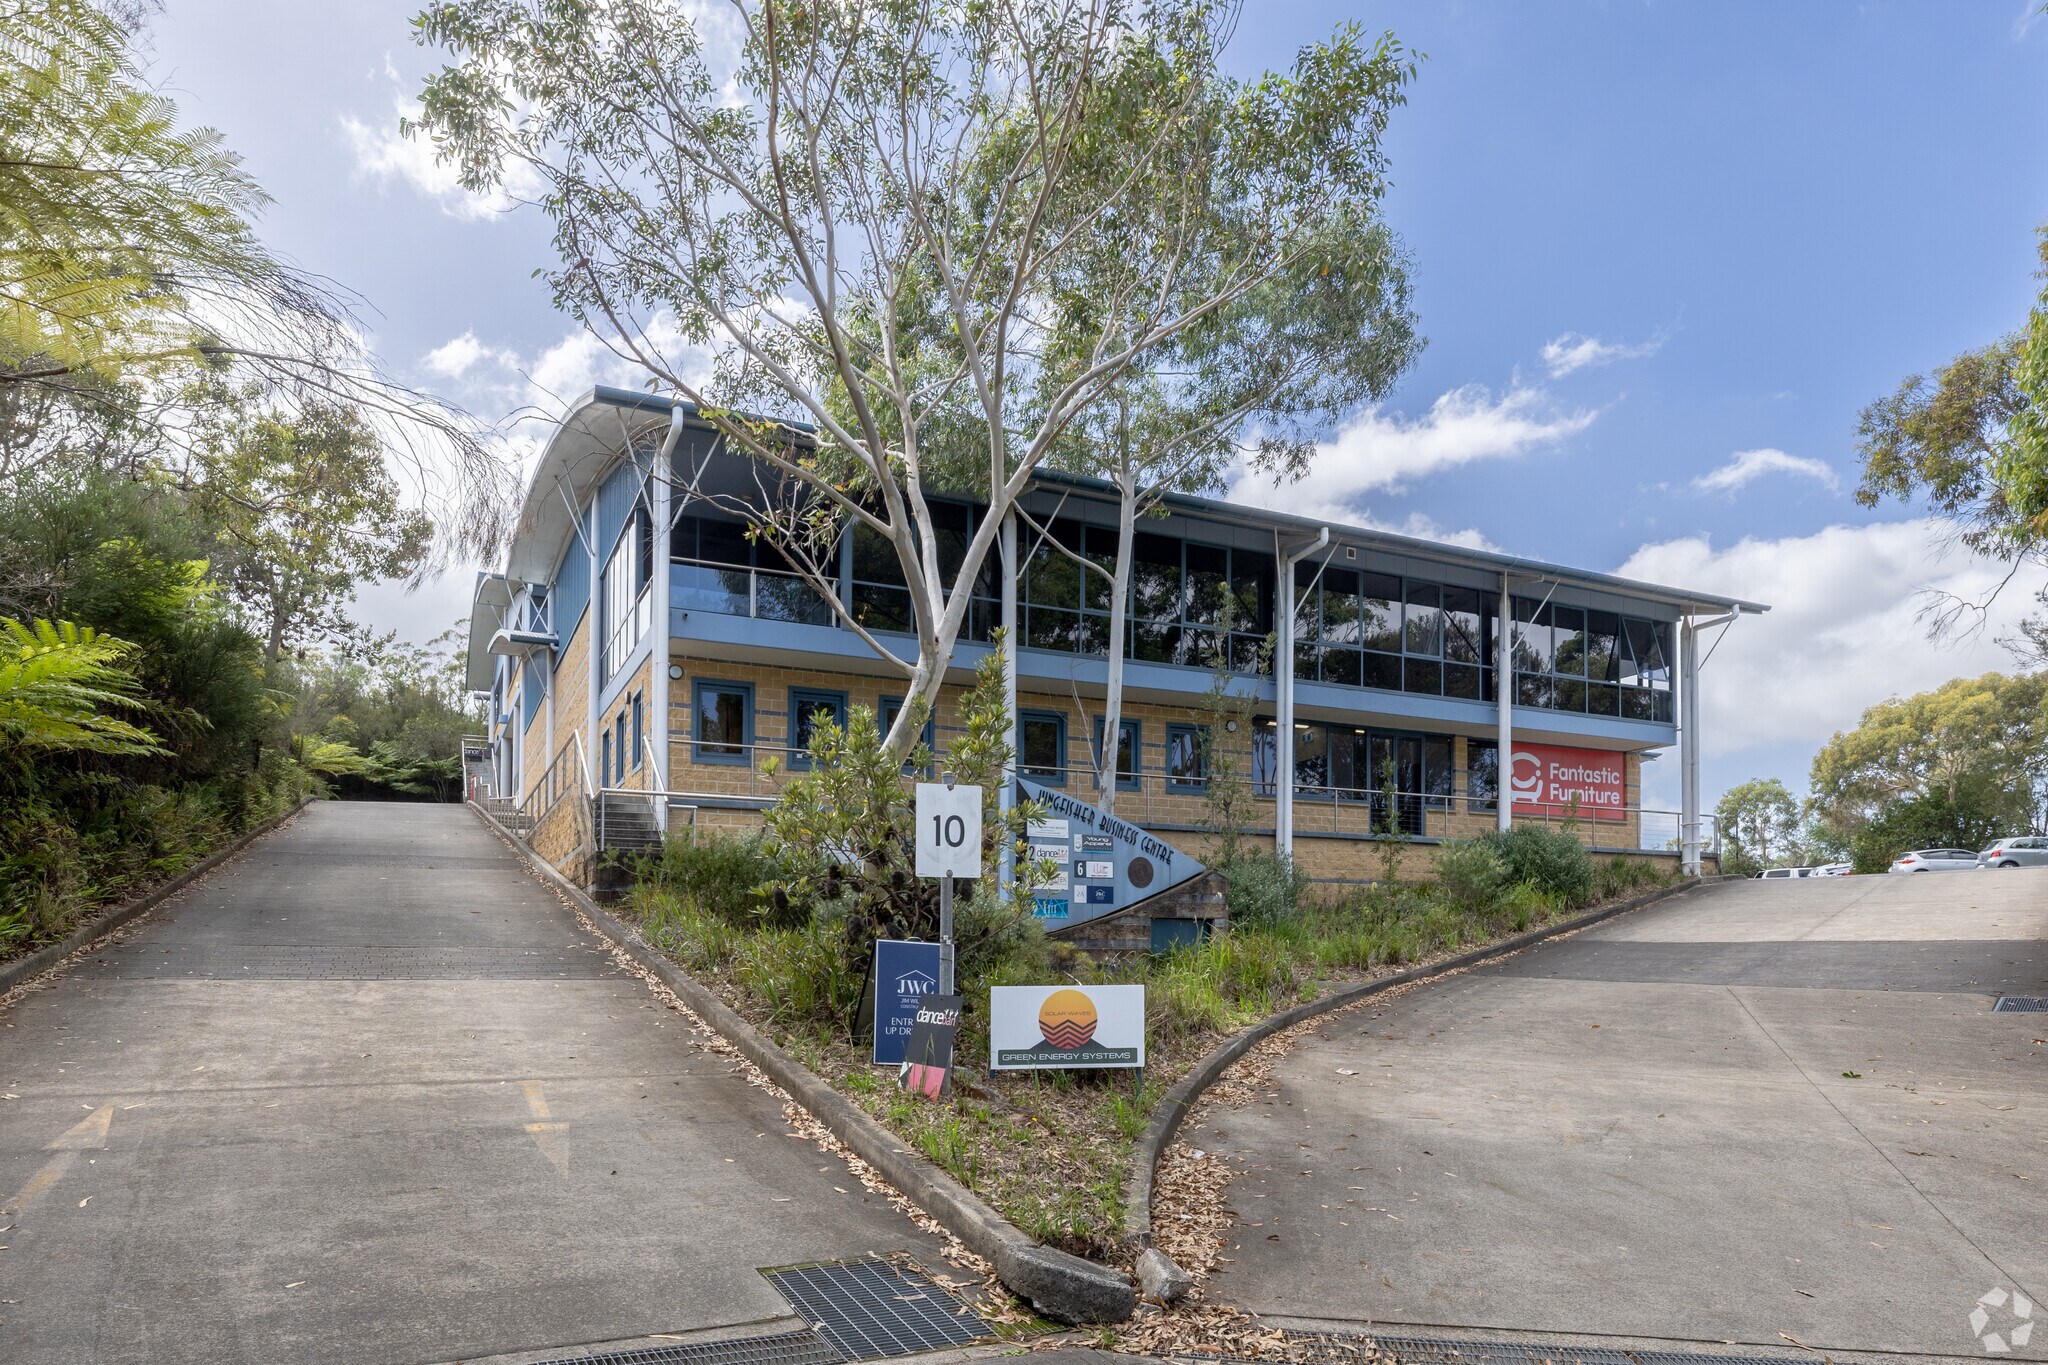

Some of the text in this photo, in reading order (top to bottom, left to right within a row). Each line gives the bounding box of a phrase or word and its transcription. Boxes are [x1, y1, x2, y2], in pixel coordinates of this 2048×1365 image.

[1549, 762, 1620, 785] Fantastic
[1549, 783, 1620, 805] Furniture
[933, 814, 965, 848] 10
[1099, 815, 1139, 846] BUSINESS
[1141, 836, 1174, 865] CENTRE
[1028, 845, 1035, 861] 2
[1077, 862, 1084, 876] 6
[897, 979, 935, 995] JWC
[885, 1027, 914, 1036] UP DR
[1002, 1053, 1037, 1061] GREEN
[1082, 1051, 1131, 1060] SYSTEMS
